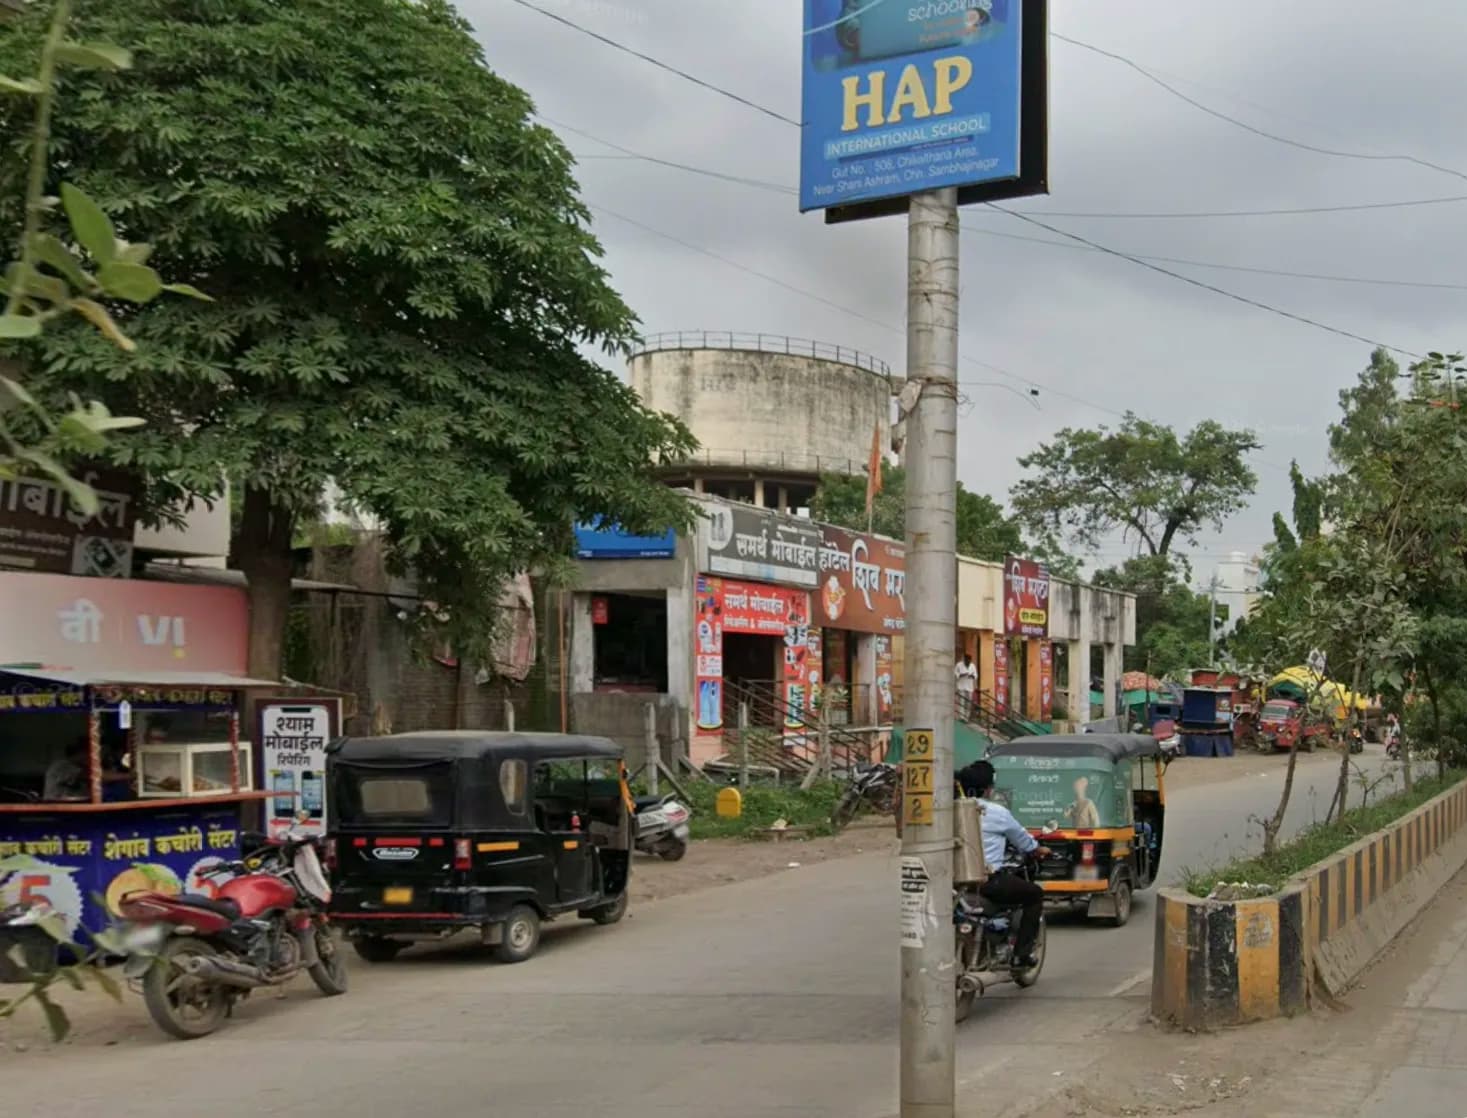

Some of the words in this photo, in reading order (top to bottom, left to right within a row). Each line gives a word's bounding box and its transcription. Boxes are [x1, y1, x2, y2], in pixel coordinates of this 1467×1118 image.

[841, 56, 973, 131] HAP
[826, 130, 927, 156] INTERNATIONAL
[931, 118, 986, 138] SCHOOL
[772, 530, 816, 568] मोबाईल
[57, 598, 102, 643] वी
[276, 716, 314, 732] श्याम
[265, 730, 324, 754] मोबाईल
[907, 734, 929, 755] 29
[906, 766, 930, 788] 127
[911, 798, 924, 818] 2
[155, 826, 204, 853] कचोरी
